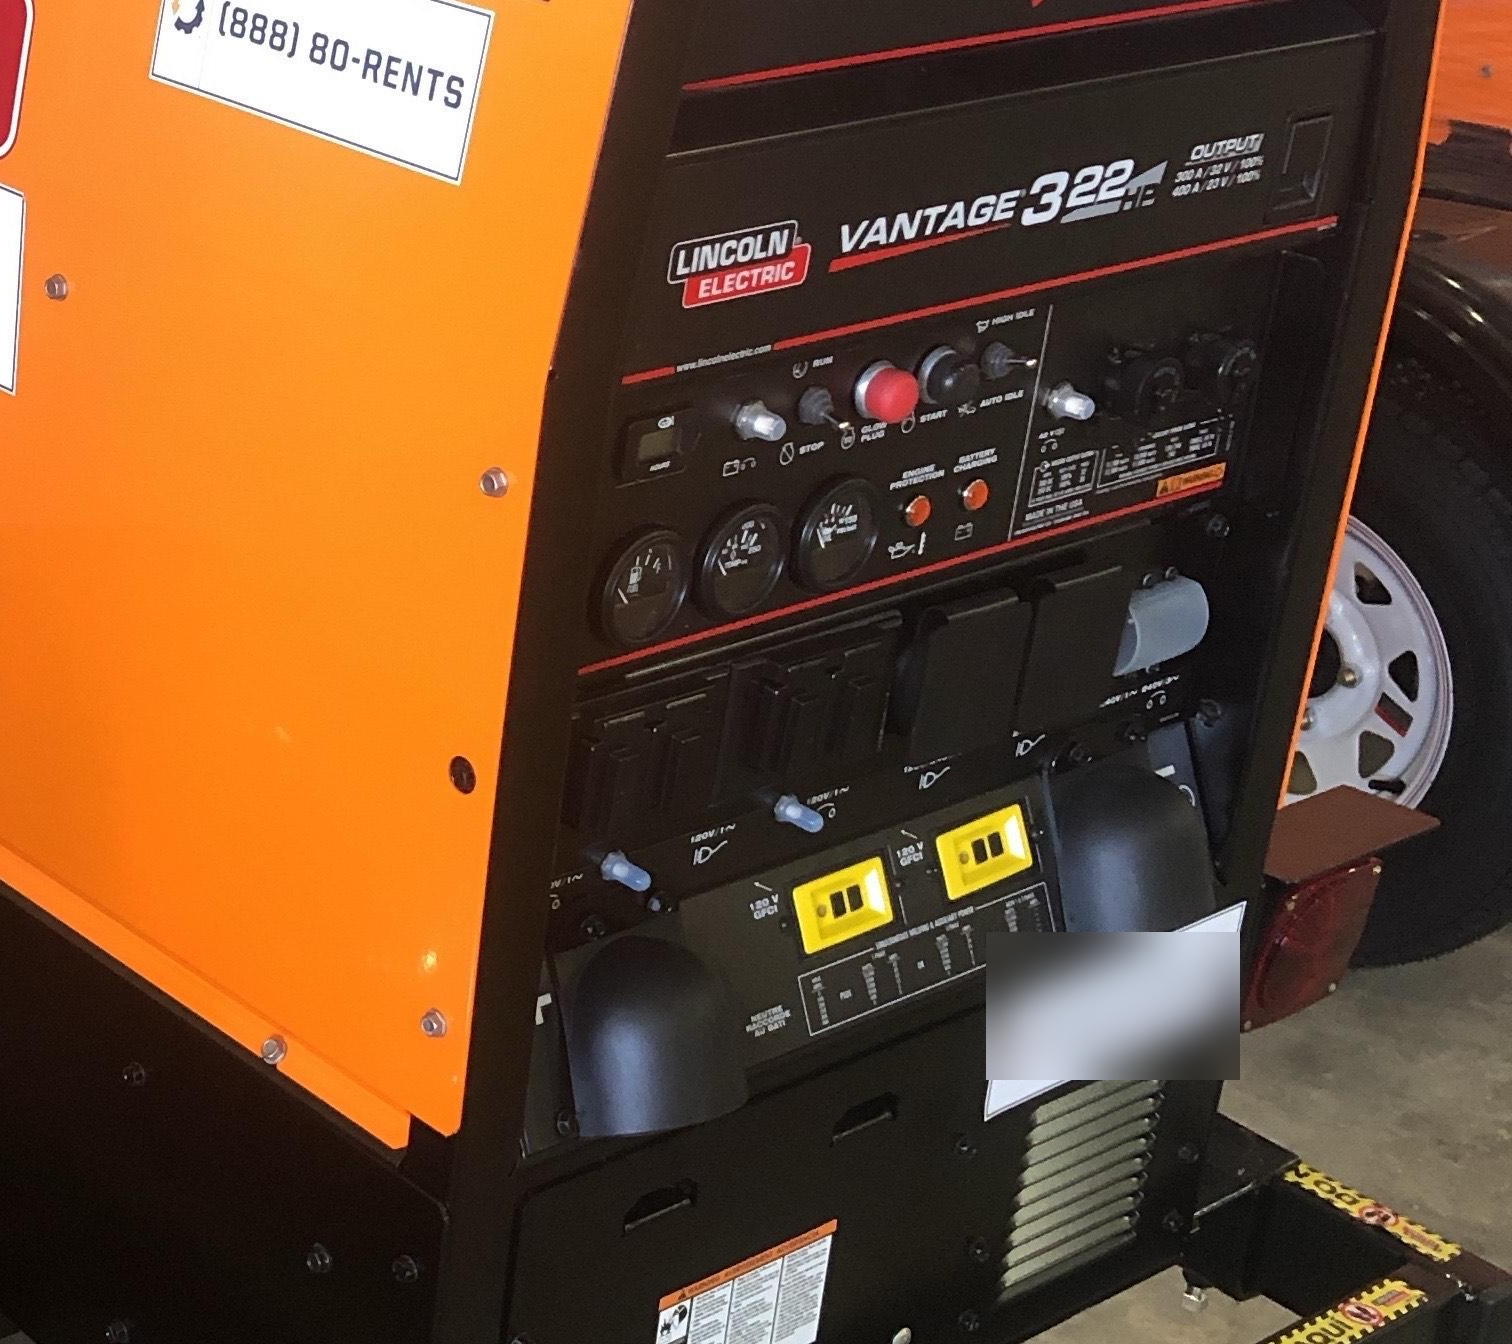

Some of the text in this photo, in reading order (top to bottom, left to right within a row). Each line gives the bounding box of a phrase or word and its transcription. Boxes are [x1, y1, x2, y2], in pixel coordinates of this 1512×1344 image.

[219, 0, 466, 110] (888) 80-RENTS
[1190, 133, 1261, 161] OUTPUT
[1021, 158, 1135, 227] 322
[675, 229, 789, 277] LINCOLN
[697, 261, 796, 300] ELECTRIC
[991, 307, 1037, 326] HIGH IDLE
[812, 355, 834, 368] RUN
[979, 389, 1025, 408] AUTO IDLE
[919, 409, 949, 424] START
[860, 429, 886, 443] PLUG
[798, 440, 825, 455] STOP
[958, 447, 997, 464] BATTERY
[901, 463, 937, 479] ENGINE
[953, 454, 999, 474] CHARGING
[889, 469, 945, 491] PROTECTION
[896, 841, 924, 859] 120 V
[899, 852, 924, 867] GFCI
[749, 893, 779, 911] 120 V
[753, 905, 779, 920] GFCI
